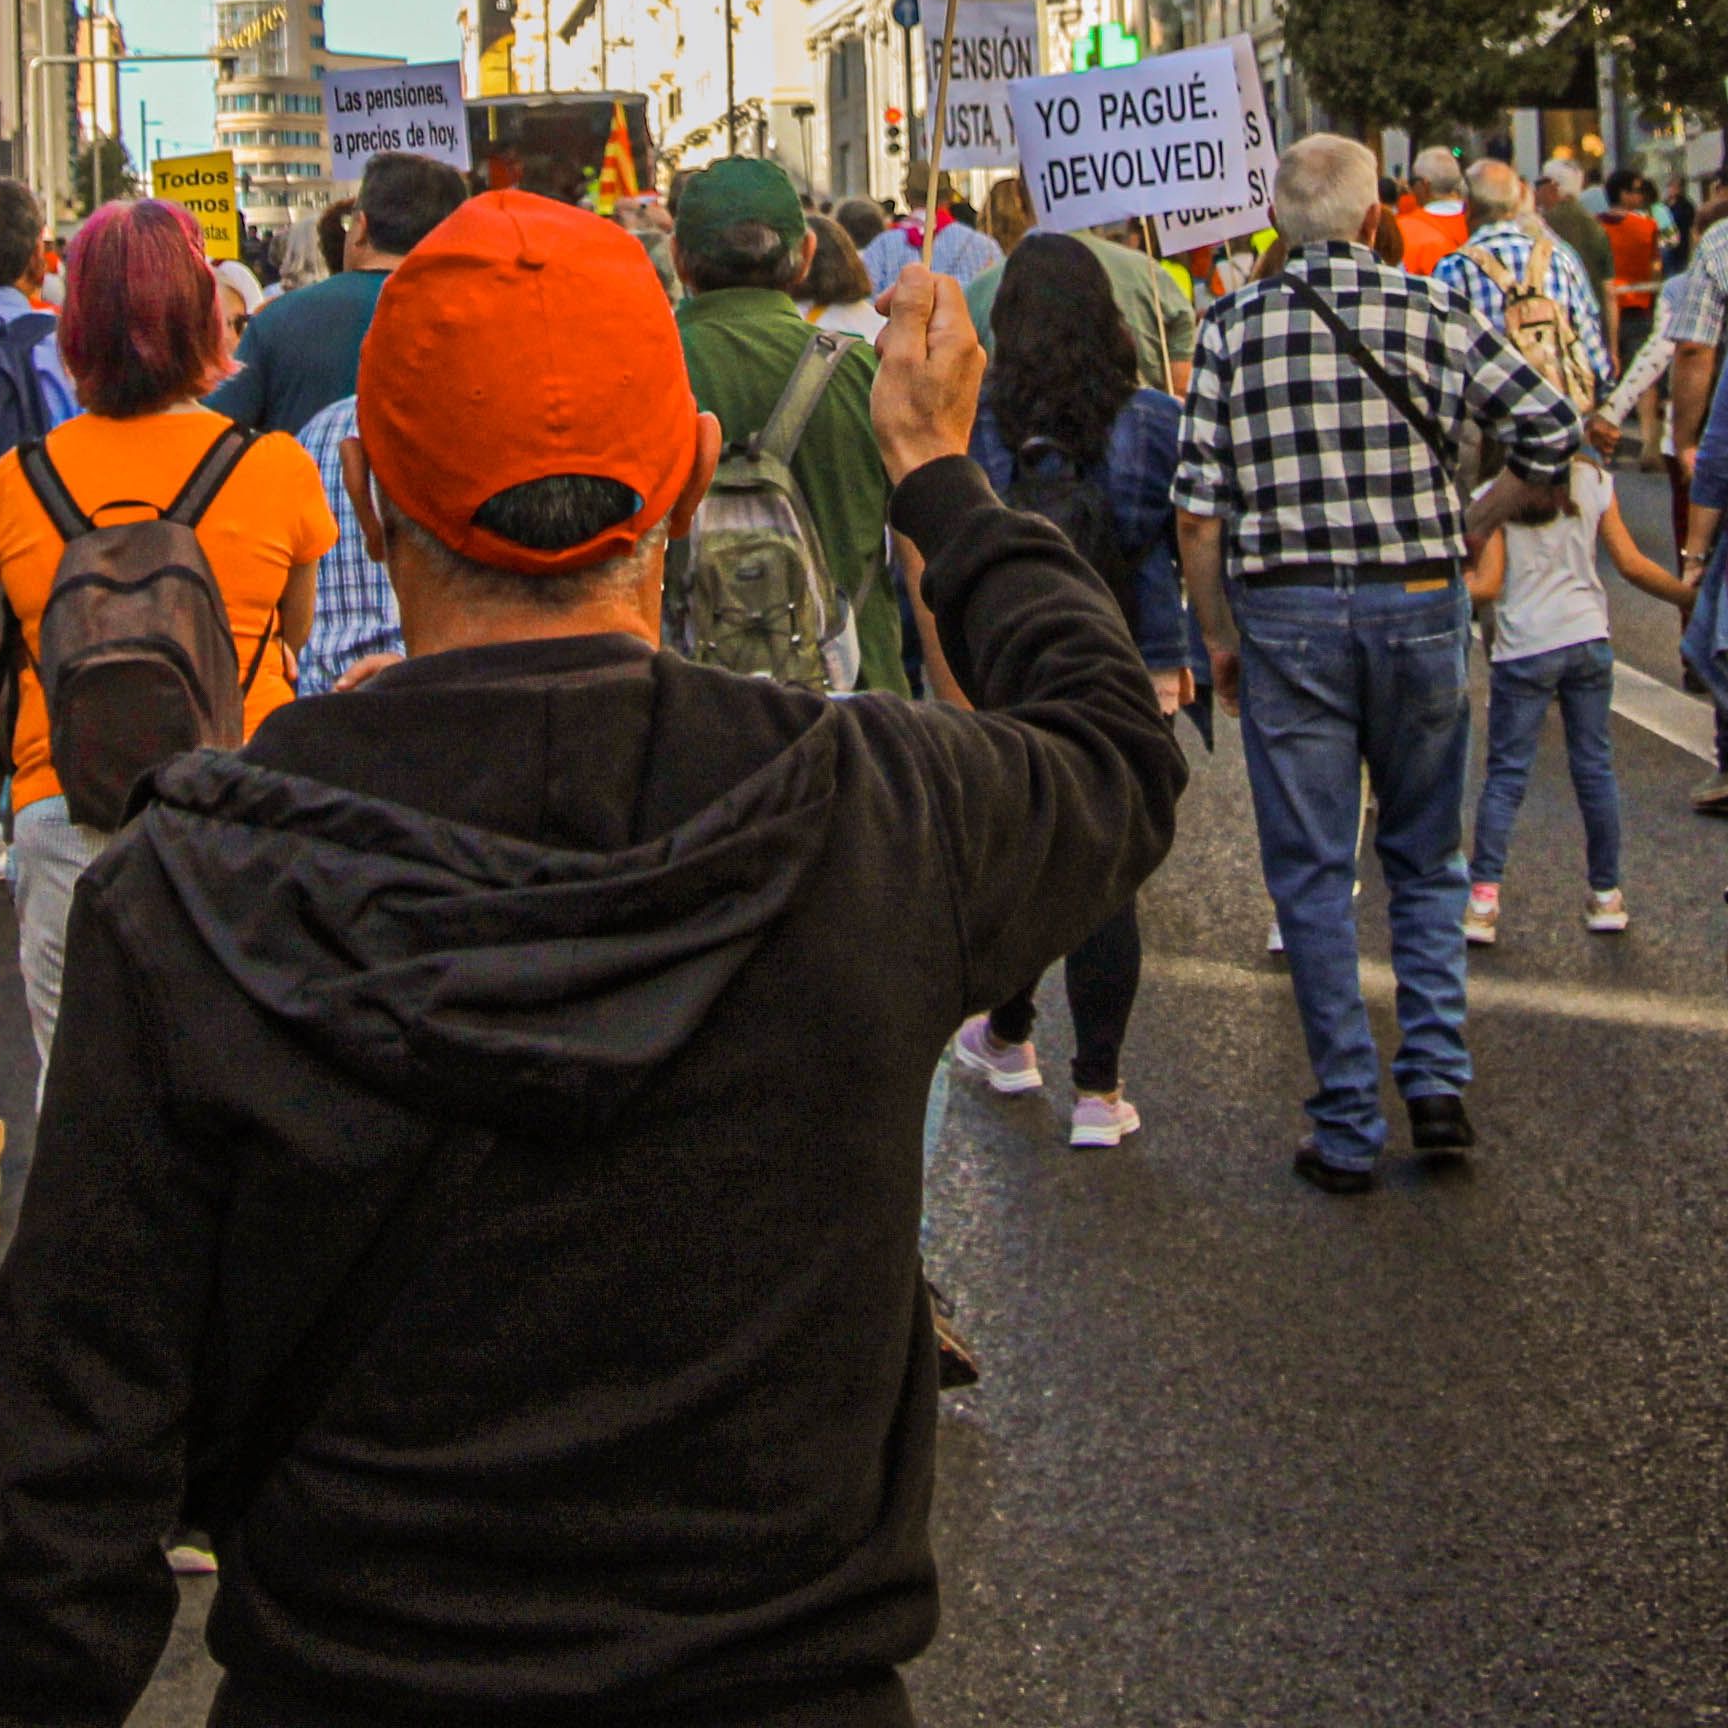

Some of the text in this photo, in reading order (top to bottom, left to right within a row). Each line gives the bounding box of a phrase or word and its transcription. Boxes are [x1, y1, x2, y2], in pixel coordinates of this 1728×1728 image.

[334, 80, 449, 117] Las pensiones,
[1035, 96, 1081, 139] YO
[1099, 73, 1218, 132] PAGUÉ.
[333, 120, 459, 160] a precios de hoy.
[943, 104, 1002, 156] USTA,
[157, 168, 229, 190] Todos
[1040, 140, 1226, 214] ¡DEVOLVED!
[183, 199, 229, 213] mos
[204, 224, 230, 241] stas.
